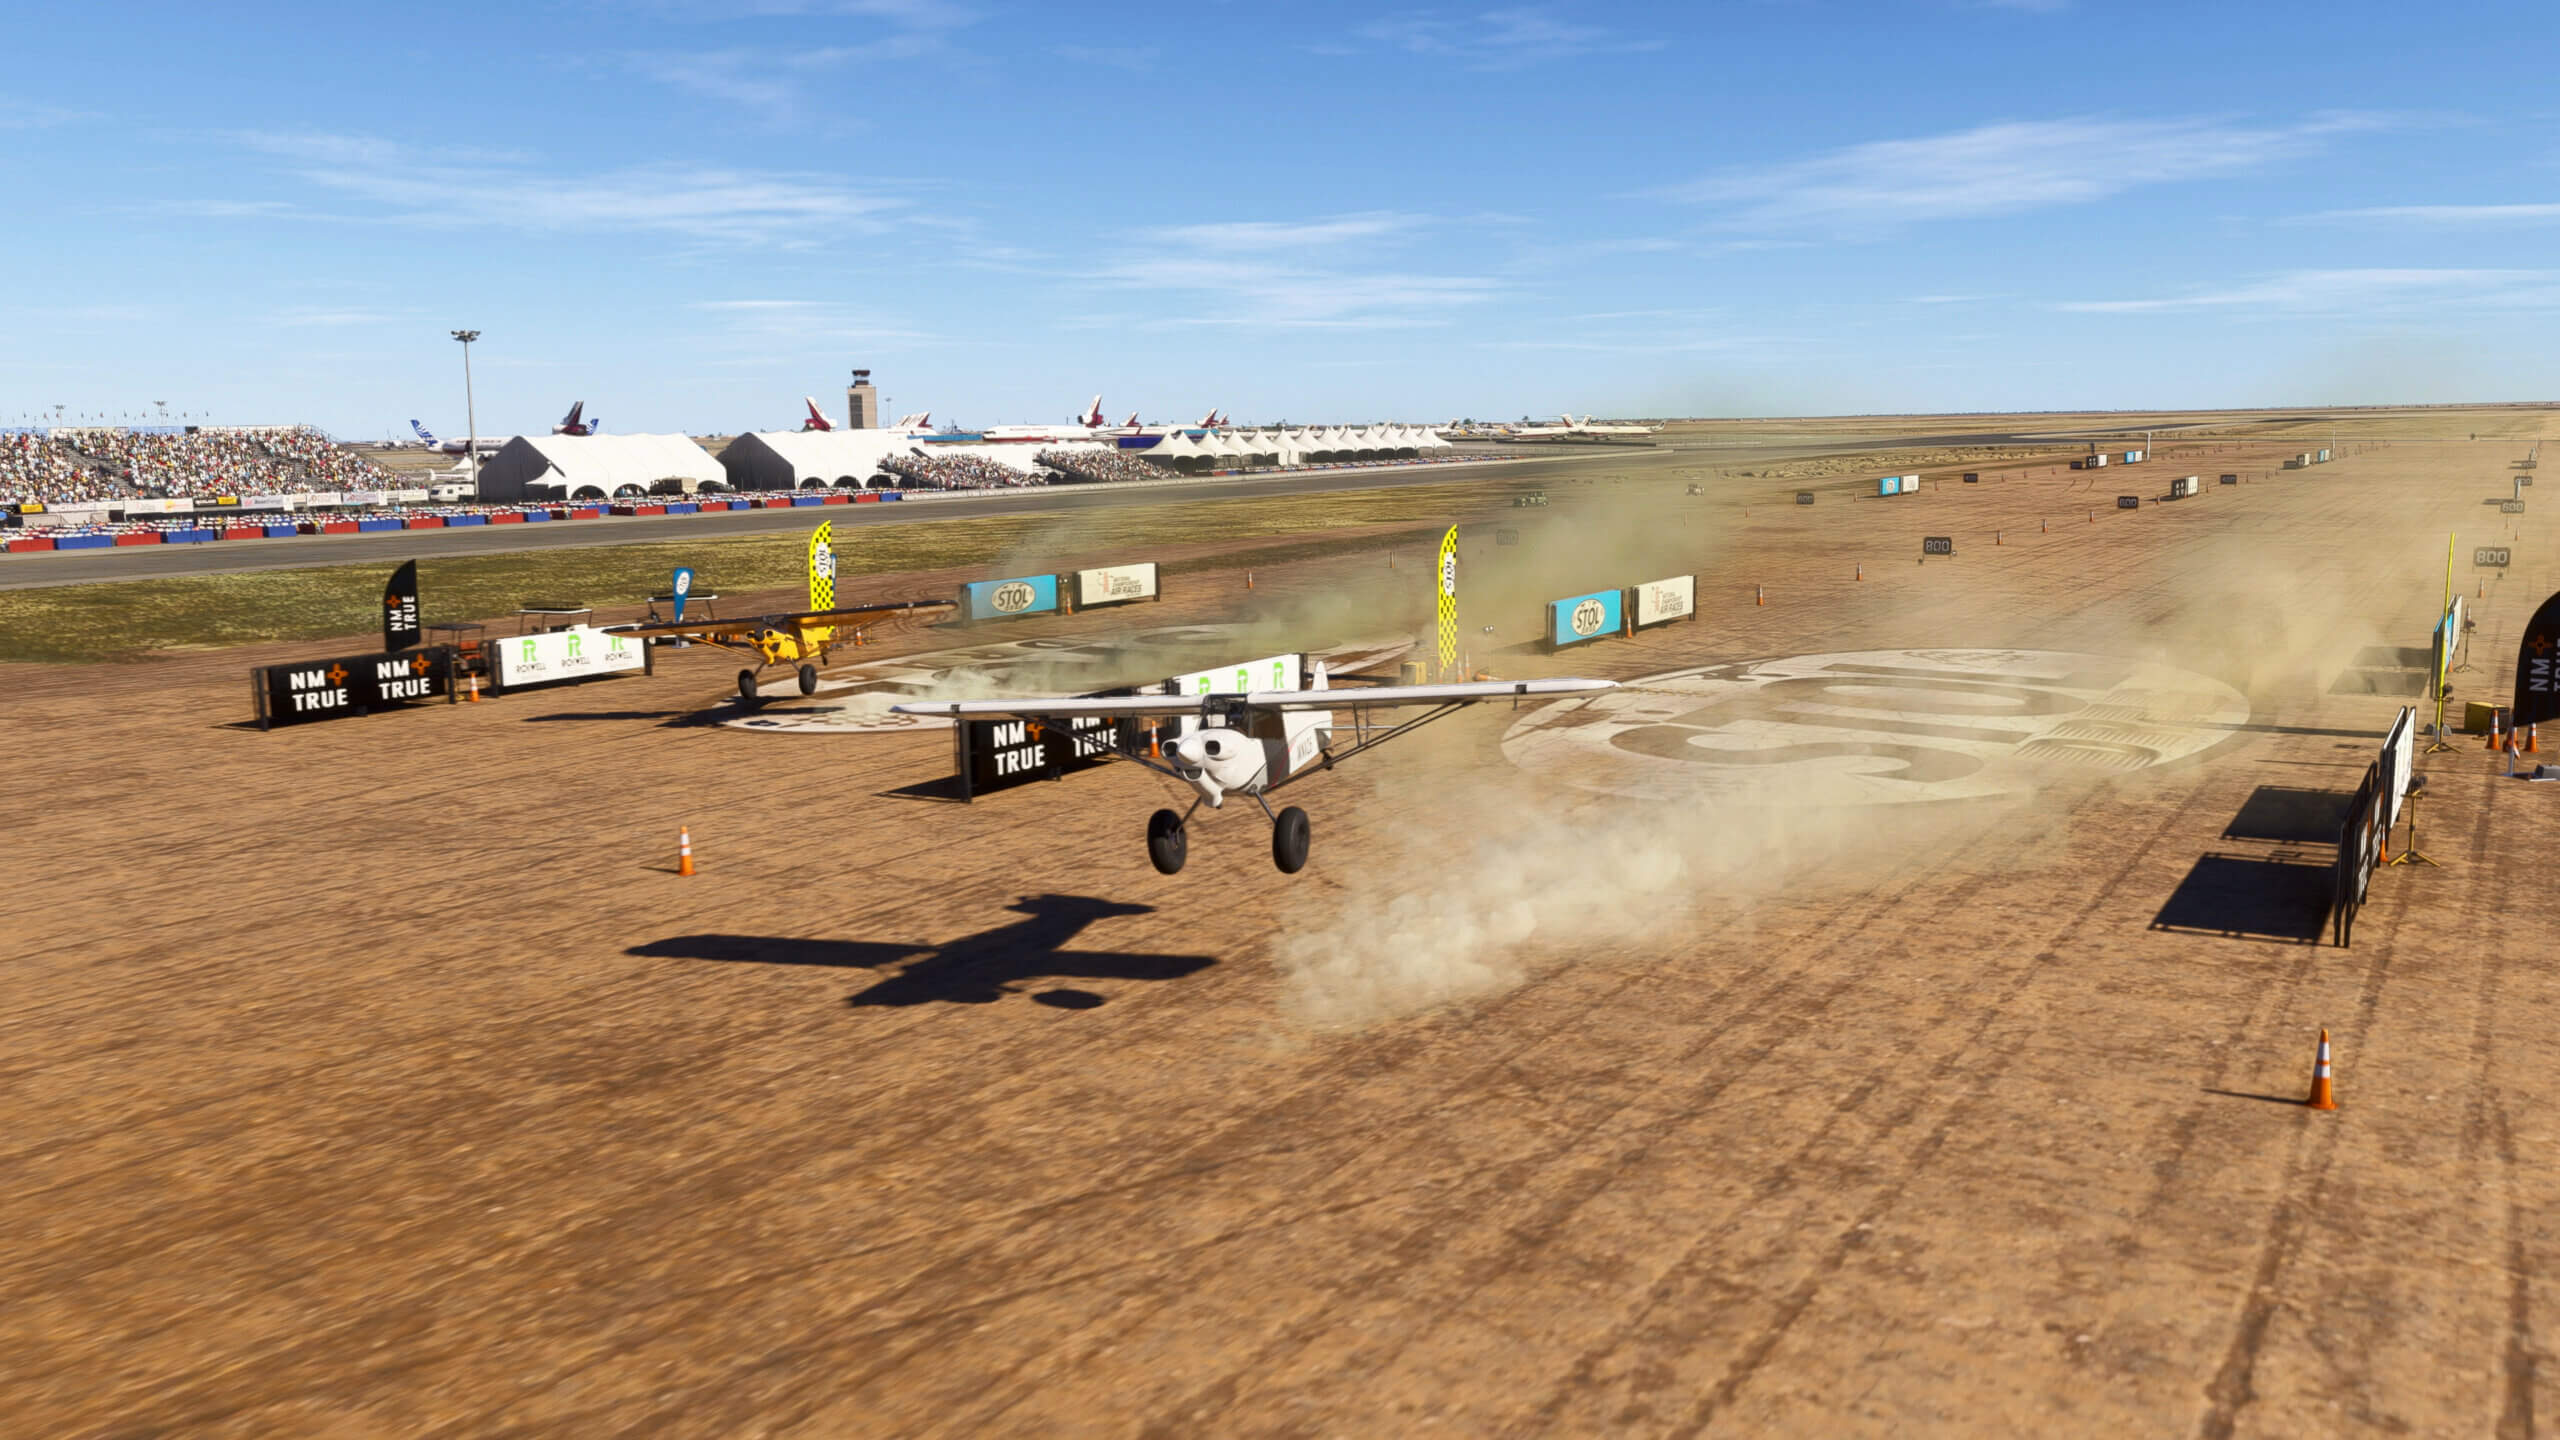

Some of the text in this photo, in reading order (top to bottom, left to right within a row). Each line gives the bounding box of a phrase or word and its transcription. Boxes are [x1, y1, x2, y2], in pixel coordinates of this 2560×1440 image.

[1926, 540, 1950, 553] 800
[2476, 550, 2508, 564] 800
[998, 588, 1028, 608] STOL
[389, 609, 403, 631] NM
[402, 596, 417, 630] TRUE
[1576, 607, 1600, 629] STOL
[290, 669, 326, 690] NM
[376, 659, 410, 679] NM
[2529, 658, 2550, 692] NM
[378, 677, 431, 700] TRUE
[292, 688, 349, 712] TRUE
[993, 720, 1026, 748] NM
[1072, 728, 1118, 757] TRUE
[994, 744, 1046, 776] TRUE
